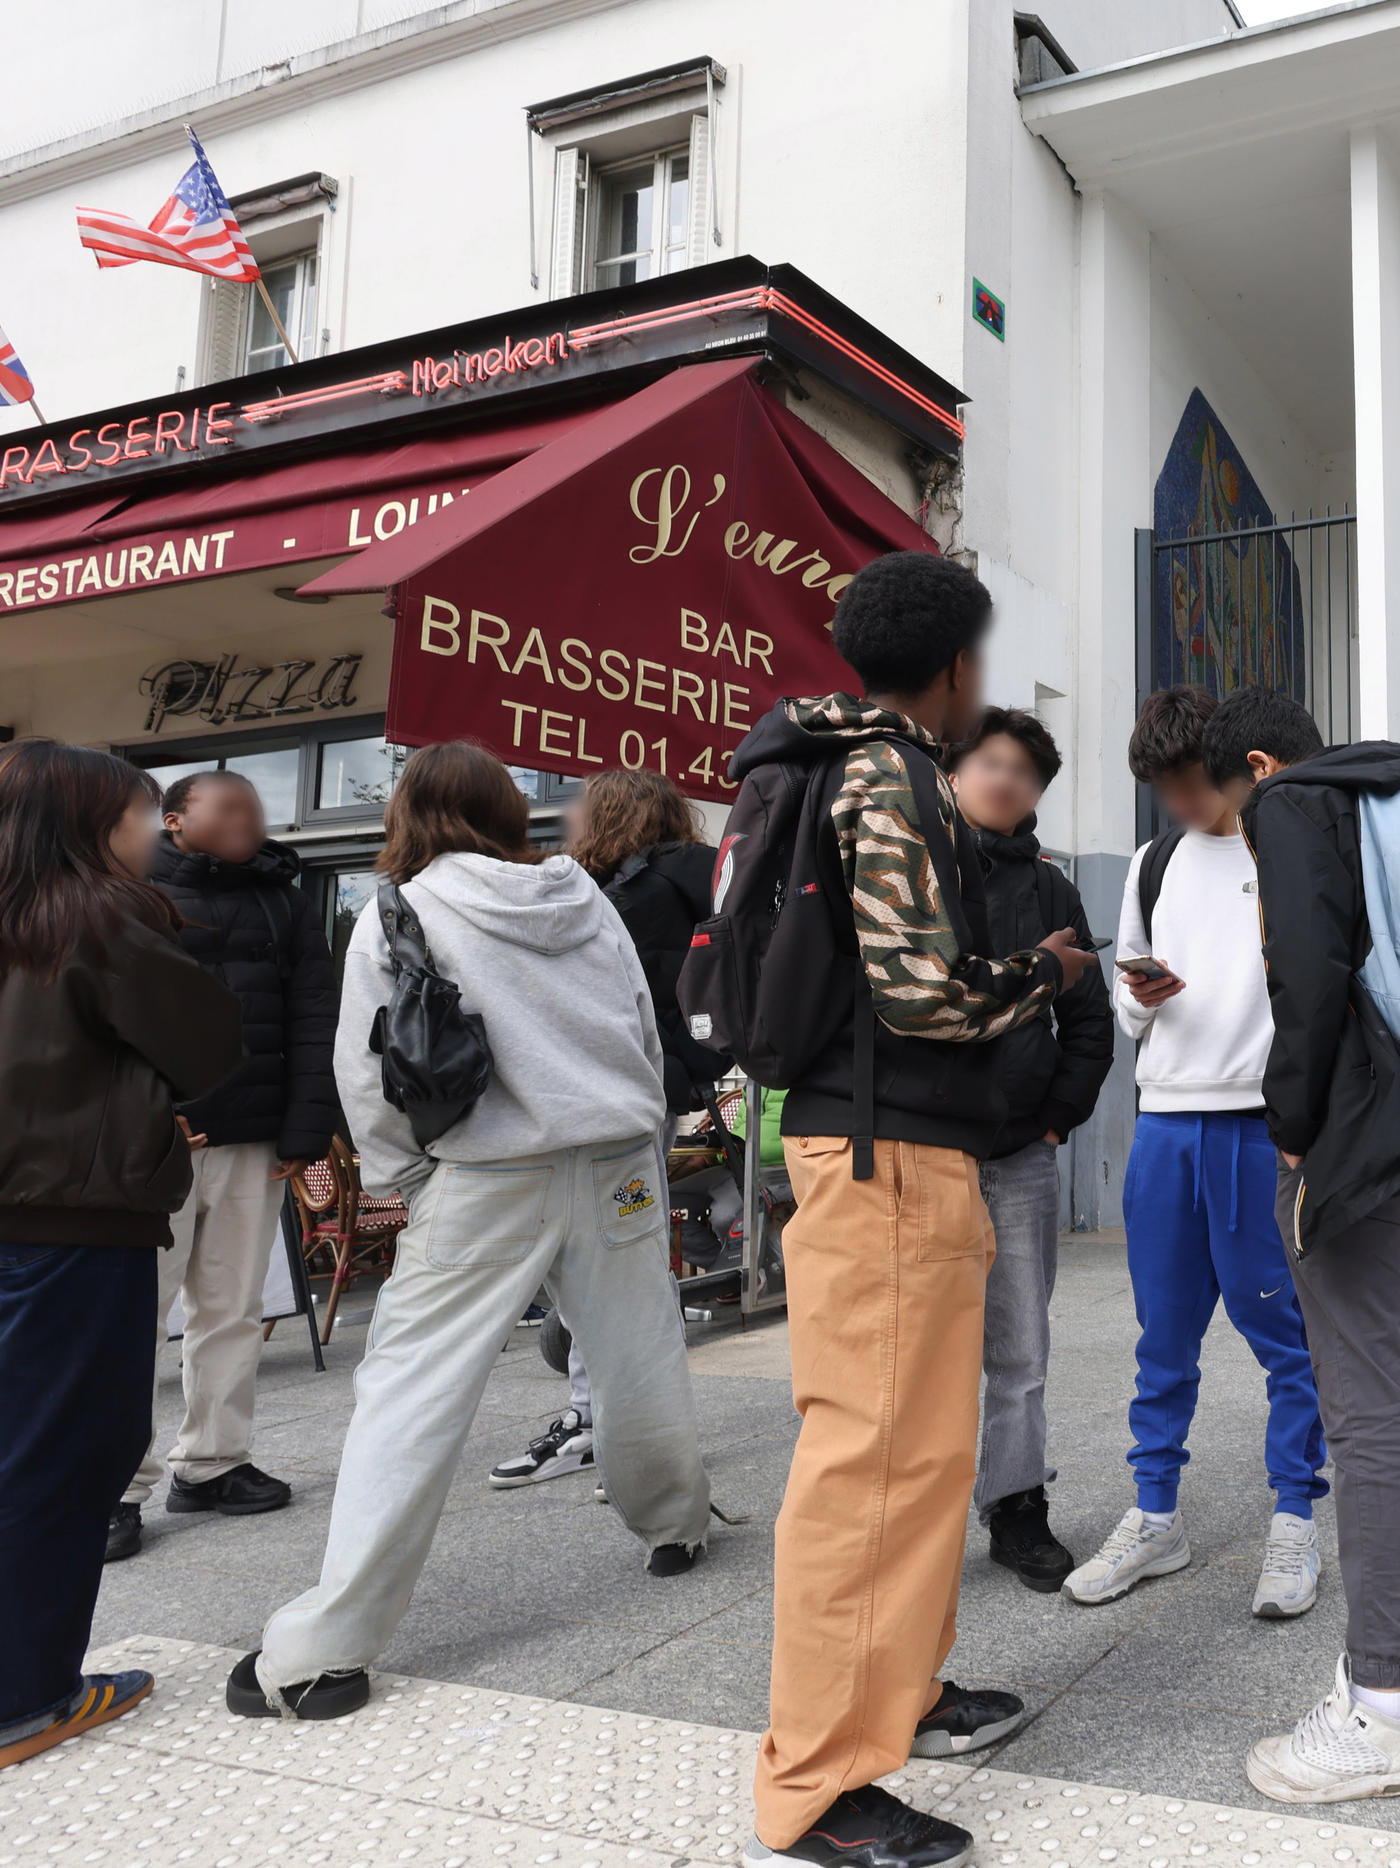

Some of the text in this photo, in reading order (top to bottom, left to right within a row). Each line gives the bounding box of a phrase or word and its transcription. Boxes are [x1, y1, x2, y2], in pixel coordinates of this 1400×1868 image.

[412, 332, 570, 397] Heineken
[0, 530, 235, 606] RESTAURANT
[348, 488, 470, 547] LOU
[629, 464, 858, 632] L'euro
[420, 595, 751, 731] BRASSERIE
[680, 607, 774, 676] BAR
[501, 699, 603, 763] TEL
